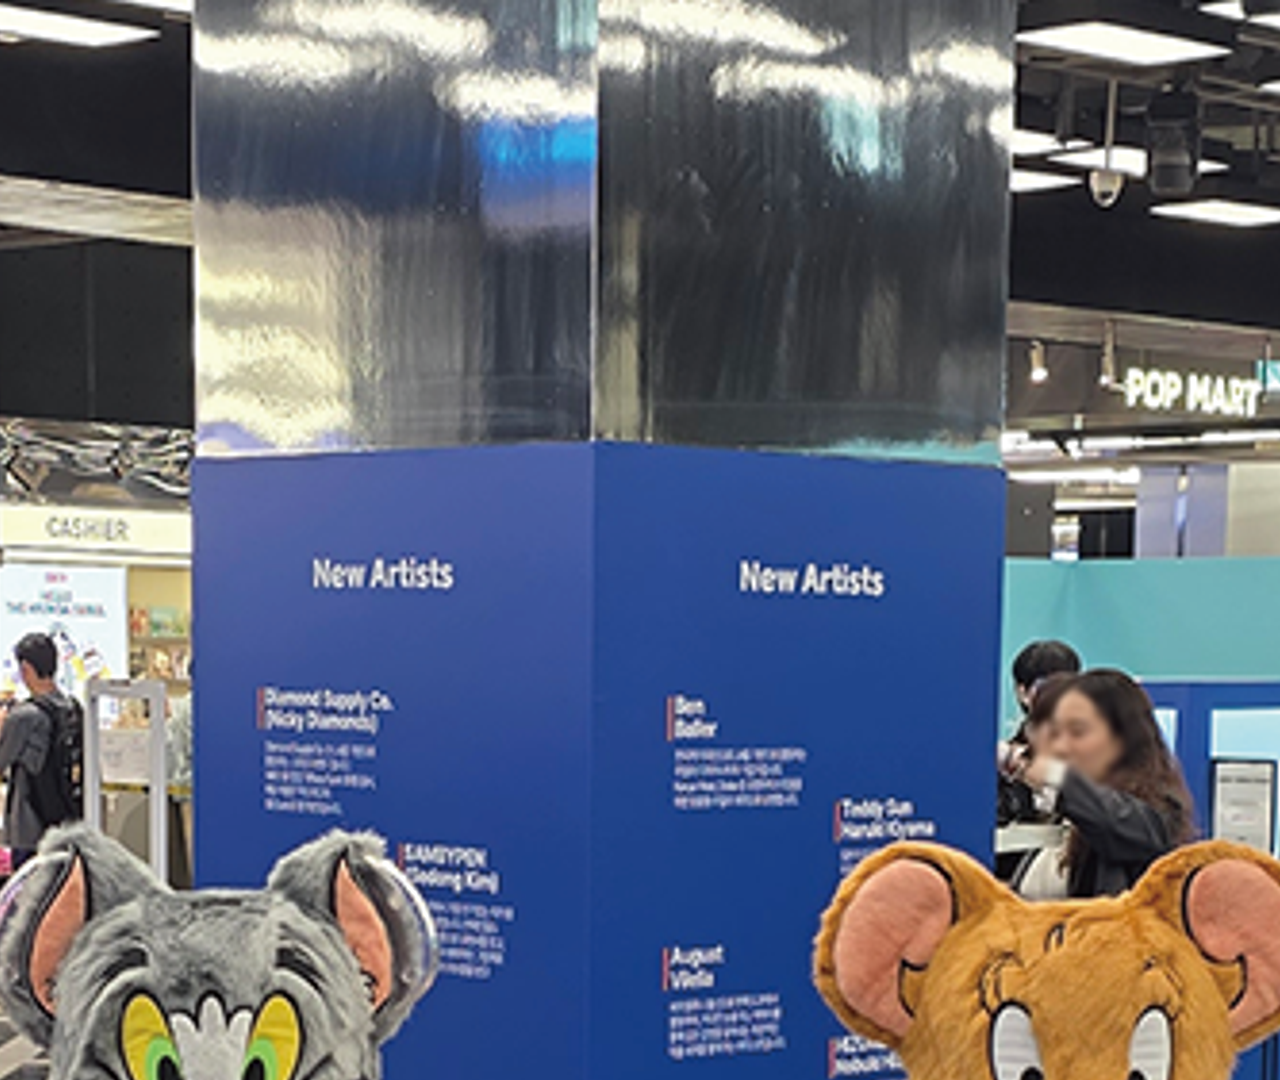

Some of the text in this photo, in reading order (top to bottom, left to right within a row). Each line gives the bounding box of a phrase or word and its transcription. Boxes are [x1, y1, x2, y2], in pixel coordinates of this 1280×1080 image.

[1126, 367, 1264, 417] POP MART
[46, 516, 128, 541] CASHIER
[312, 556, 454, 589] New Artists
[739, 559, 885, 597] New Artists
[674, 694, 706, 716] Ben
[671, 946, 725, 968] August
